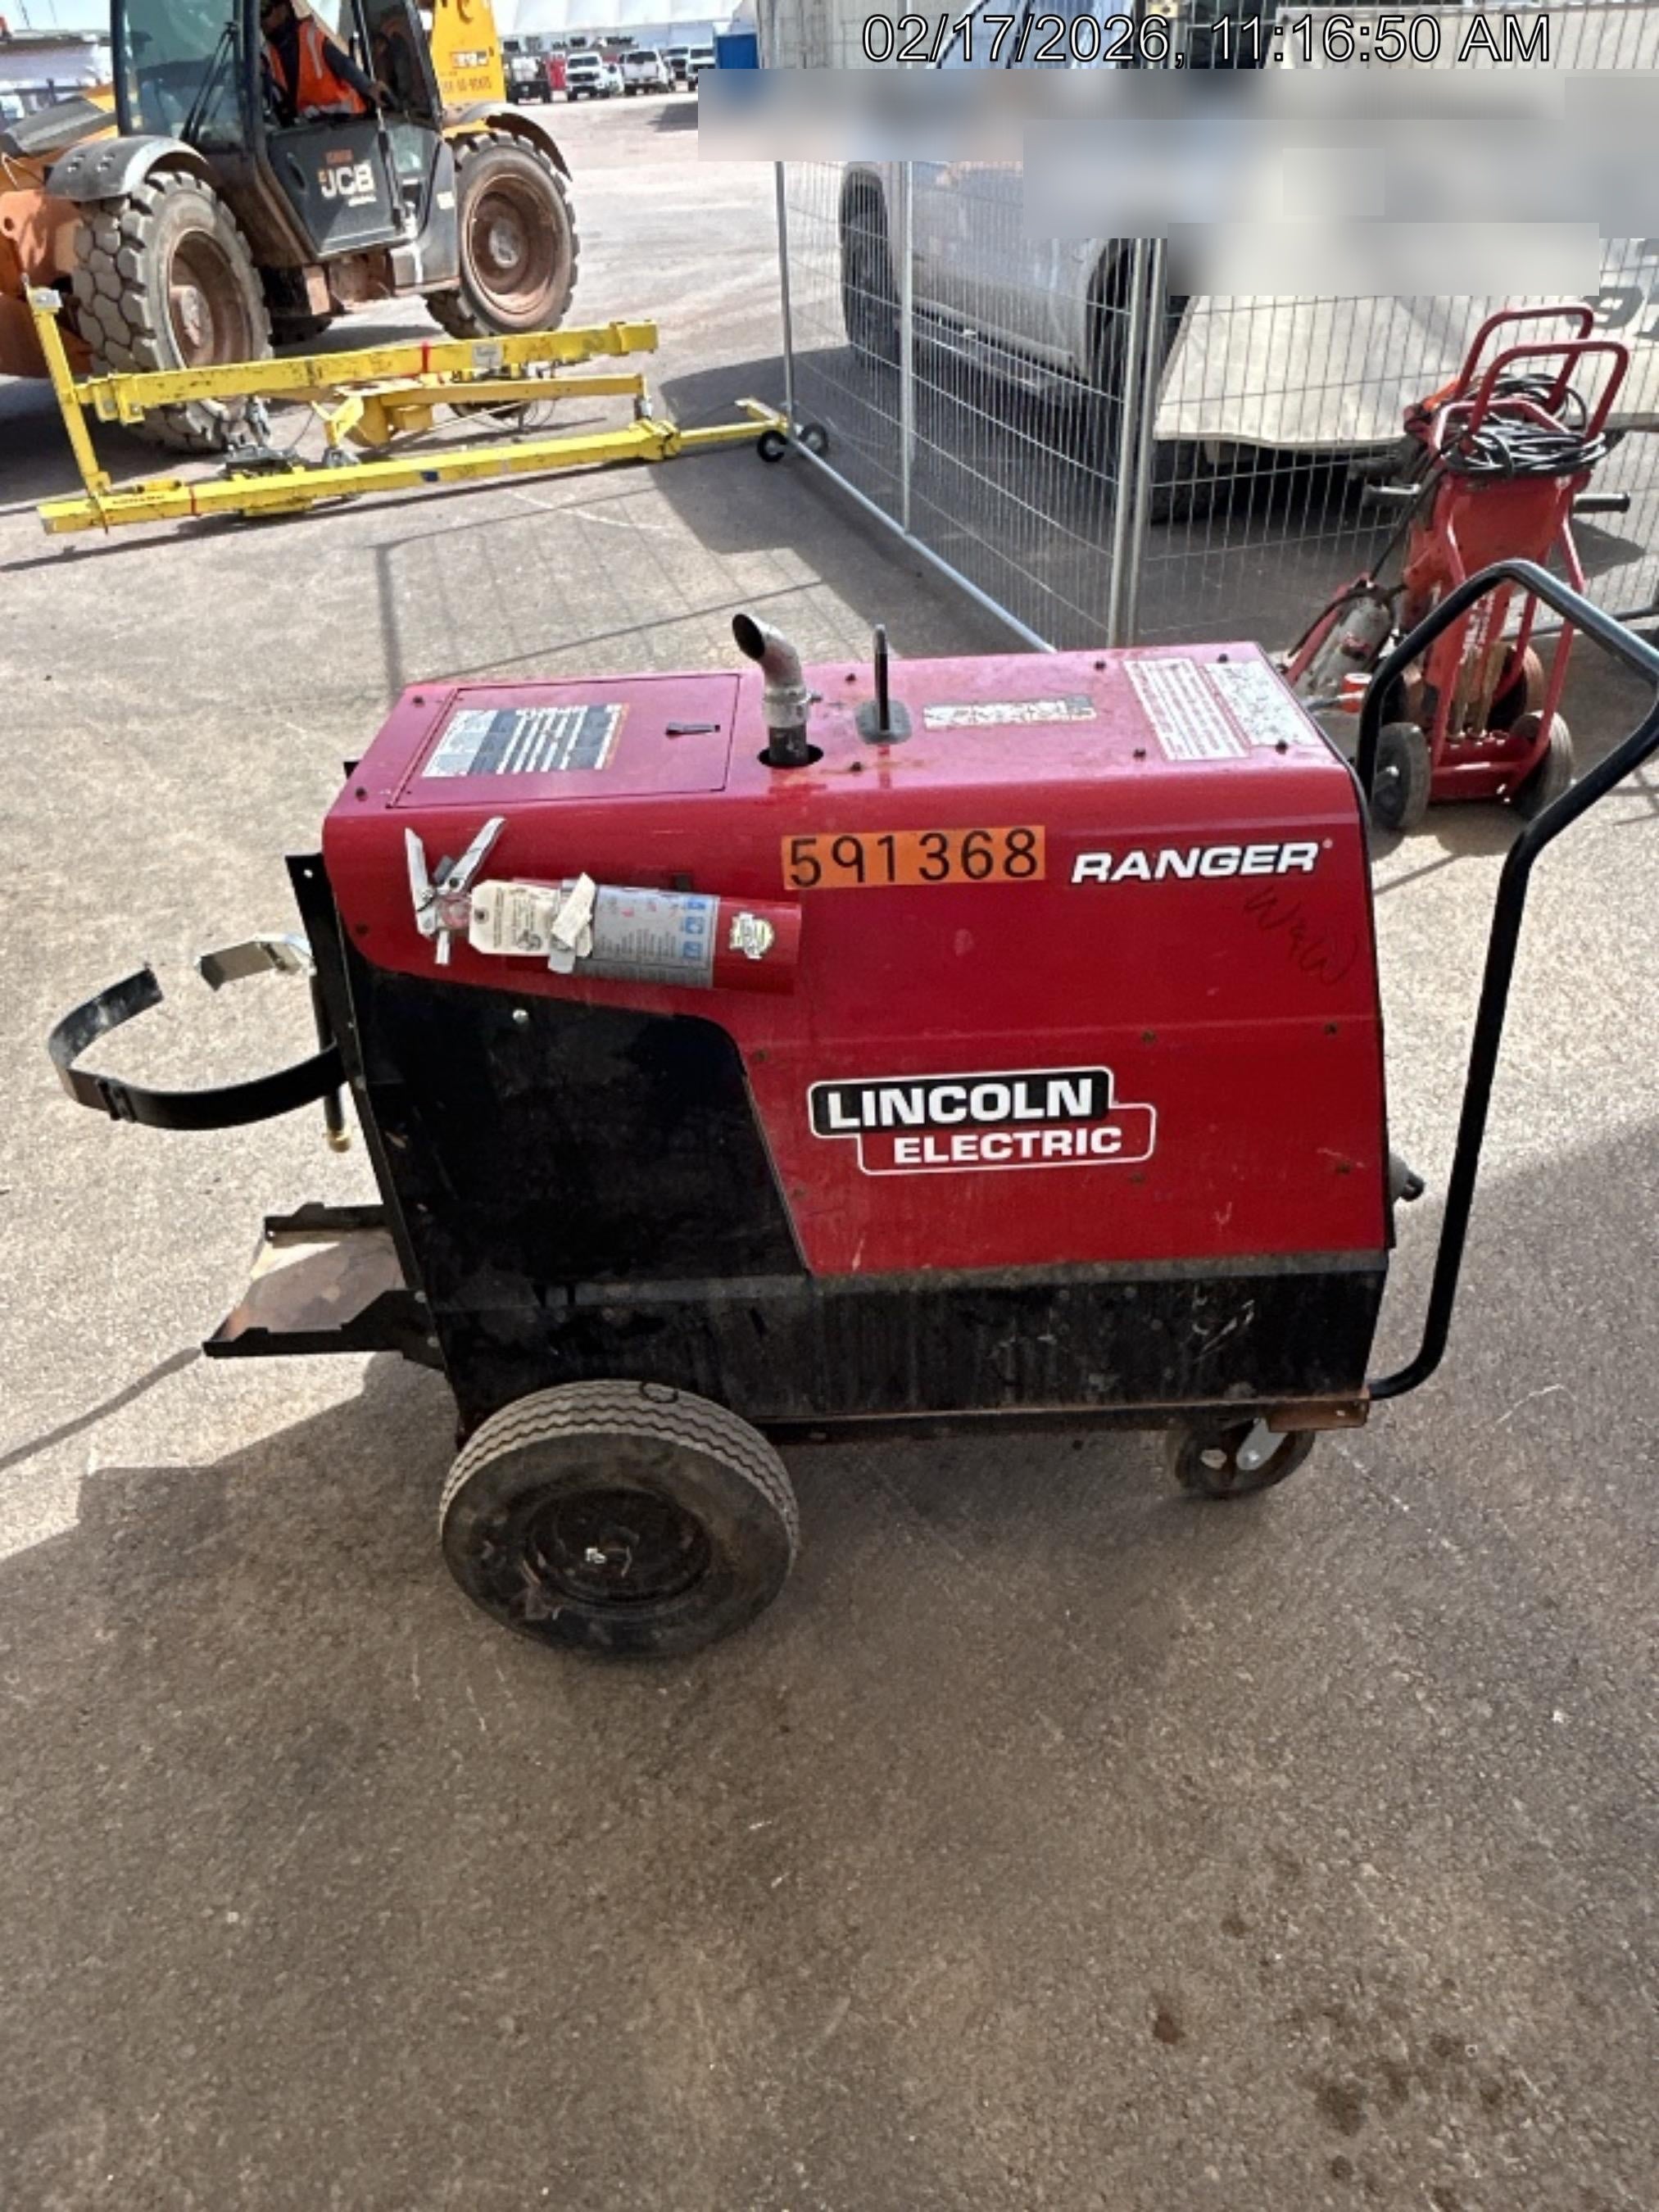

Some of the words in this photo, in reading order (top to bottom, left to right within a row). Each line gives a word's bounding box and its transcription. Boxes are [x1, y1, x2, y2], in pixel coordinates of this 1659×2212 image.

[317, 160, 376, 198] JCB
[790, 827, 1038, 888] 591368
[827, 1077, 1093, 1130] LINCOLN
[893, 1126, 1123, 1164] ELECTRIC
